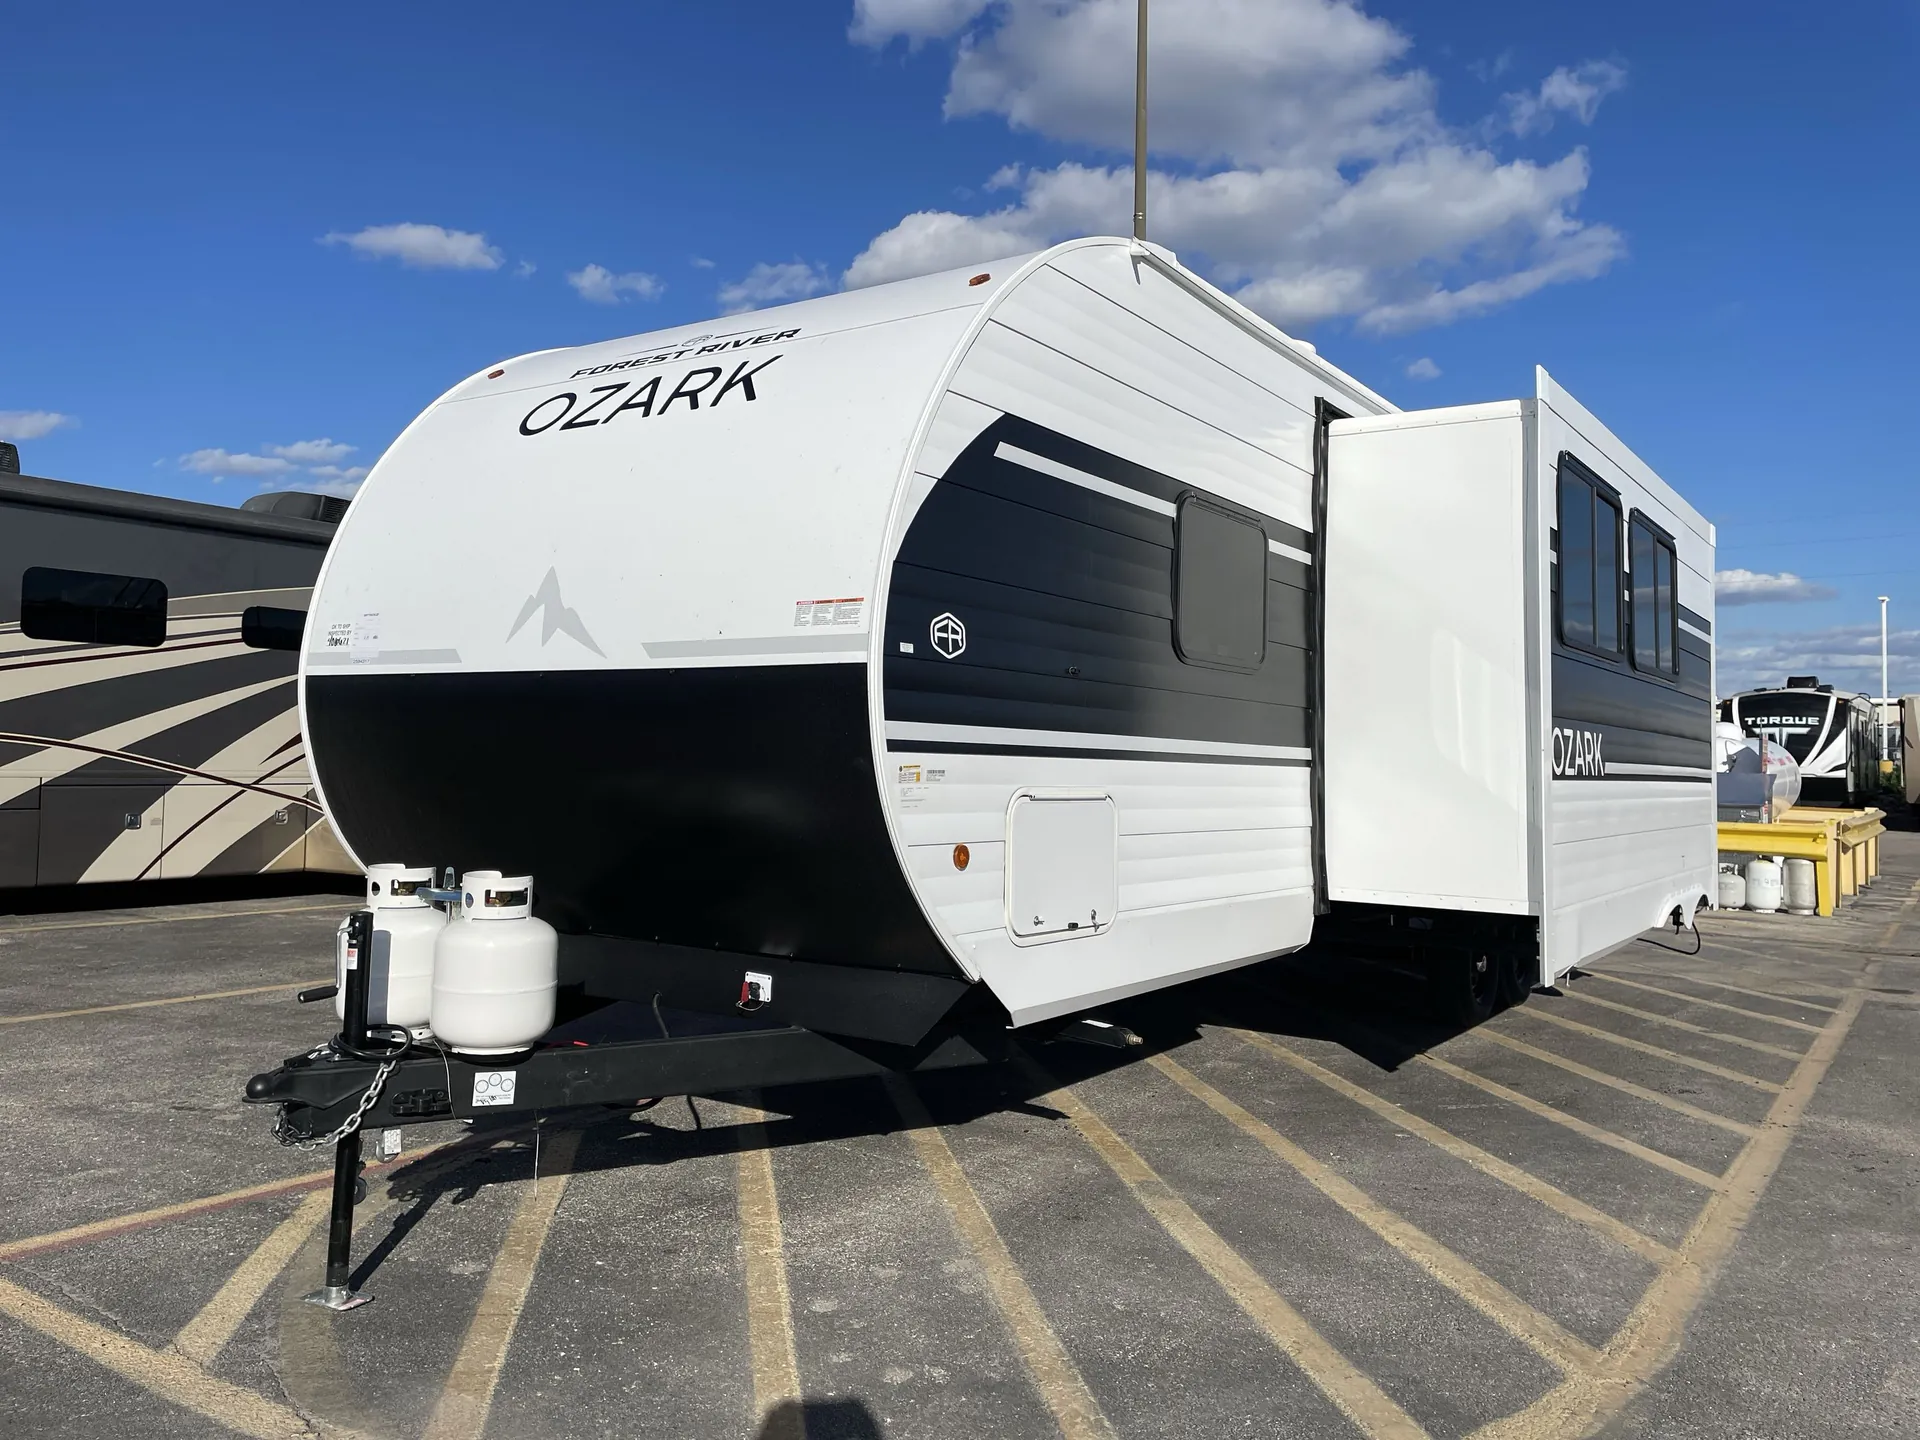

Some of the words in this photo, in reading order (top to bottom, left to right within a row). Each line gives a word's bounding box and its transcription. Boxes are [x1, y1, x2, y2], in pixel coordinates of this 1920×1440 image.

[570, 348, 694, 379] FOREST
[695, 328, 802, 356] RIVER
[518, 355, 784, 436] OZARK
[1744, 716, 1820, 725] TORQUE
[1551, 726, 1605, 777] OZARK
